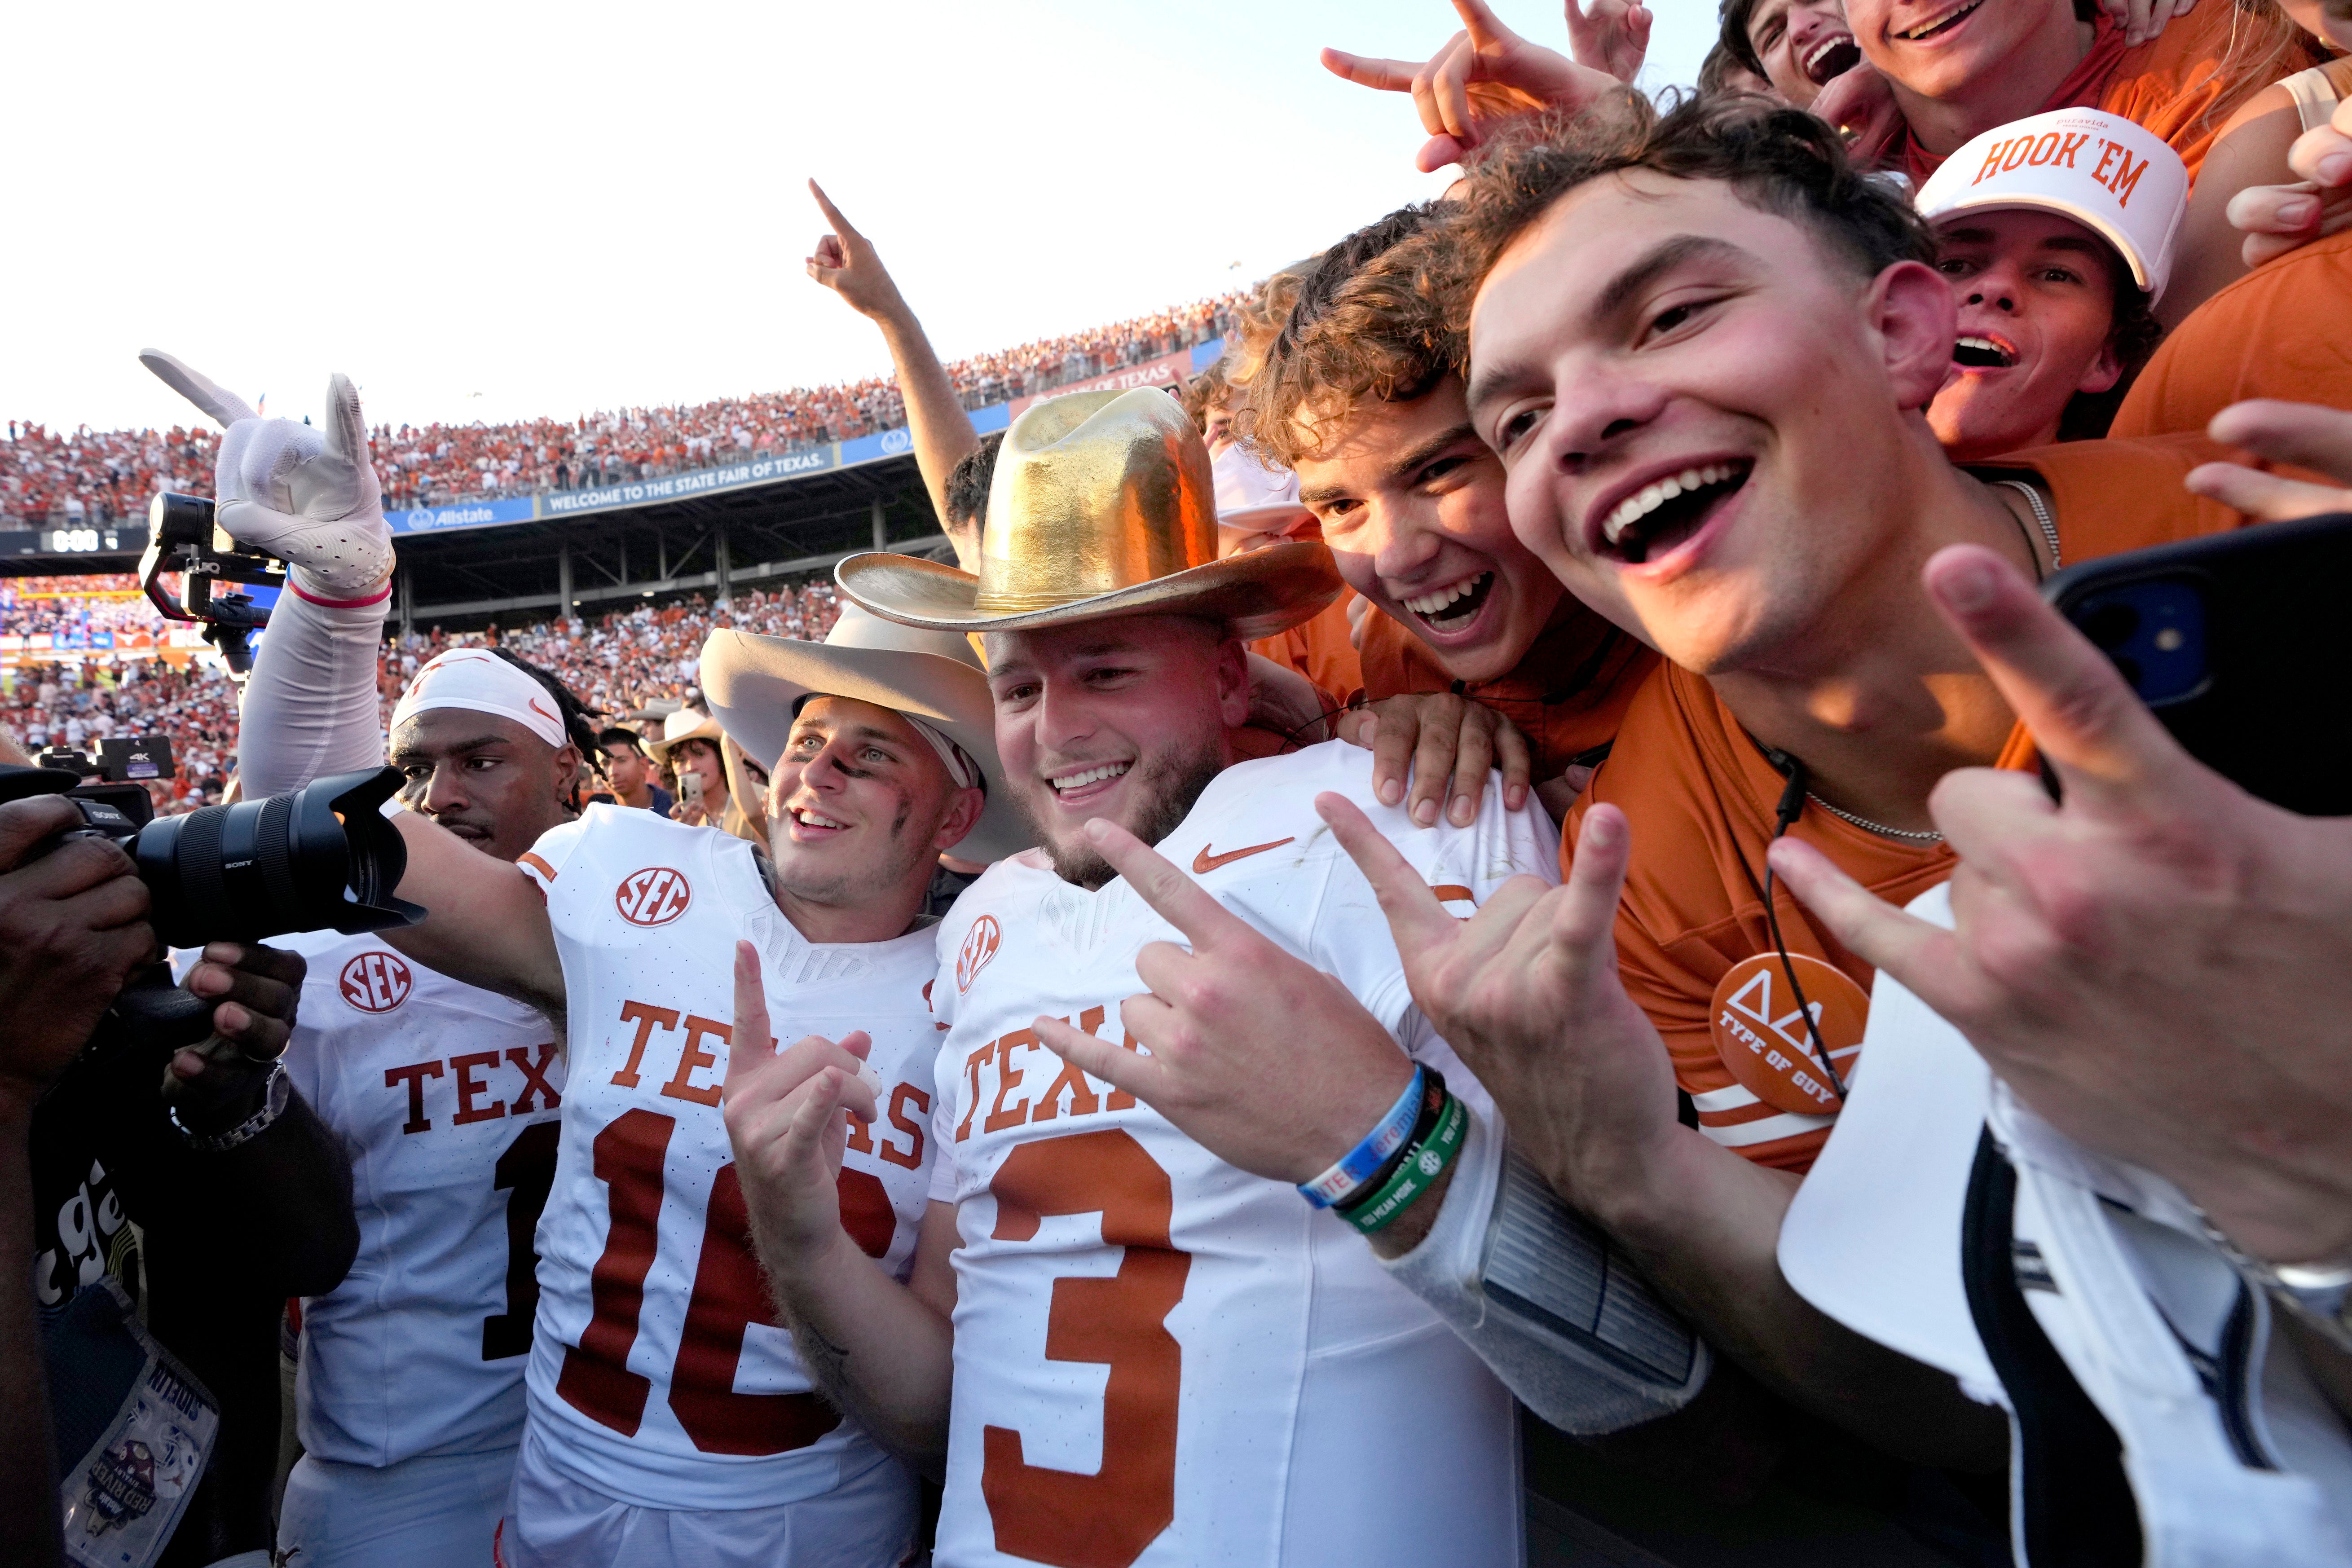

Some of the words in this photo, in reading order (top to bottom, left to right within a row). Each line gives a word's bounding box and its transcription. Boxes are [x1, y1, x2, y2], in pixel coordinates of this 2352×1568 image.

[1971, 132, 2090, 187] HOOK
[2091, 138, 2149, 209] 'EM
[1118, 363, 1171, 389] TEXAS
[549, 489, 622, 511] WELCOME
[622, 485, 644, 500] TO
[645, 480, 673, 498] THE
[675, 472, 716, 493] STATE
[718, 466, 750, 485] FAIR
[752, 461, 774, 478] OF
[435, 506, 493, 527] Allstate
[129, 752, 150, 761] 4K
[92, 810, 121, 820] SONY
[225, 859, 253, 869] SONY
[619, 869, 687, 922] SEC
[958, 917, 998, 989] SEC
[344, 955, 408, 1009] SEC
[1718, 1010, 1767, 1055] TYPE
[1765, 1049, 1793, 1072] OF
[1791, 1070, 1835, 1104] GUY
[610, 999, 931, 1171] TES
[1359, 1213, 1377, 1227] YOU
[1372, 1197, 1398, 1220] MEAN
[1392, 1177, 1418, 1203] MORE
[980, 1128, 1192, 1568] 3
[92, 1461, 127, 1499] RIVER
[123, 1490, 154, 1512] RED
